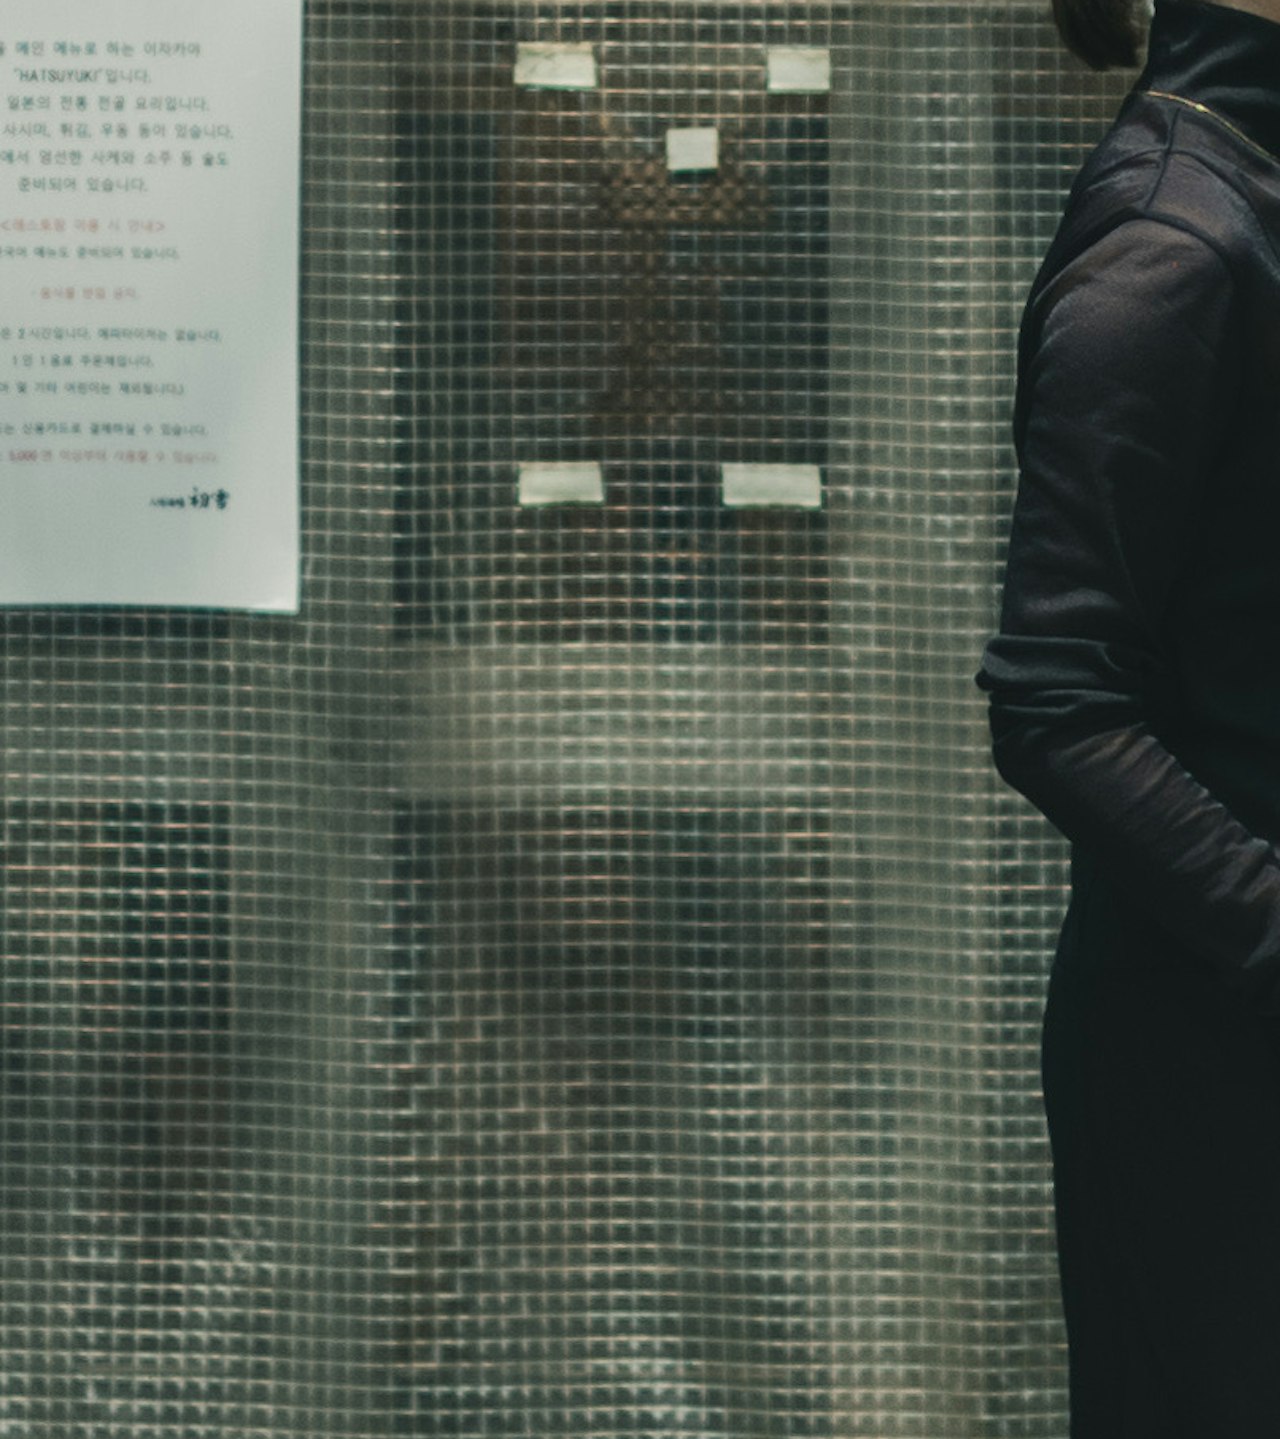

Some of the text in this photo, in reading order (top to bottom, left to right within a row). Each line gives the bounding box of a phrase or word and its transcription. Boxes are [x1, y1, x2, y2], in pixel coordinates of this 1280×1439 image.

[53, 40, 97, 57] 메뉴로
[106, 41, 135, 57] 하는
[143, 42, 201, 58] 이자카야
[7, 95, 51, 112] 일본의
[92, 150, 136, 166] 사케와
[145, 150, 172, 165] 소주
